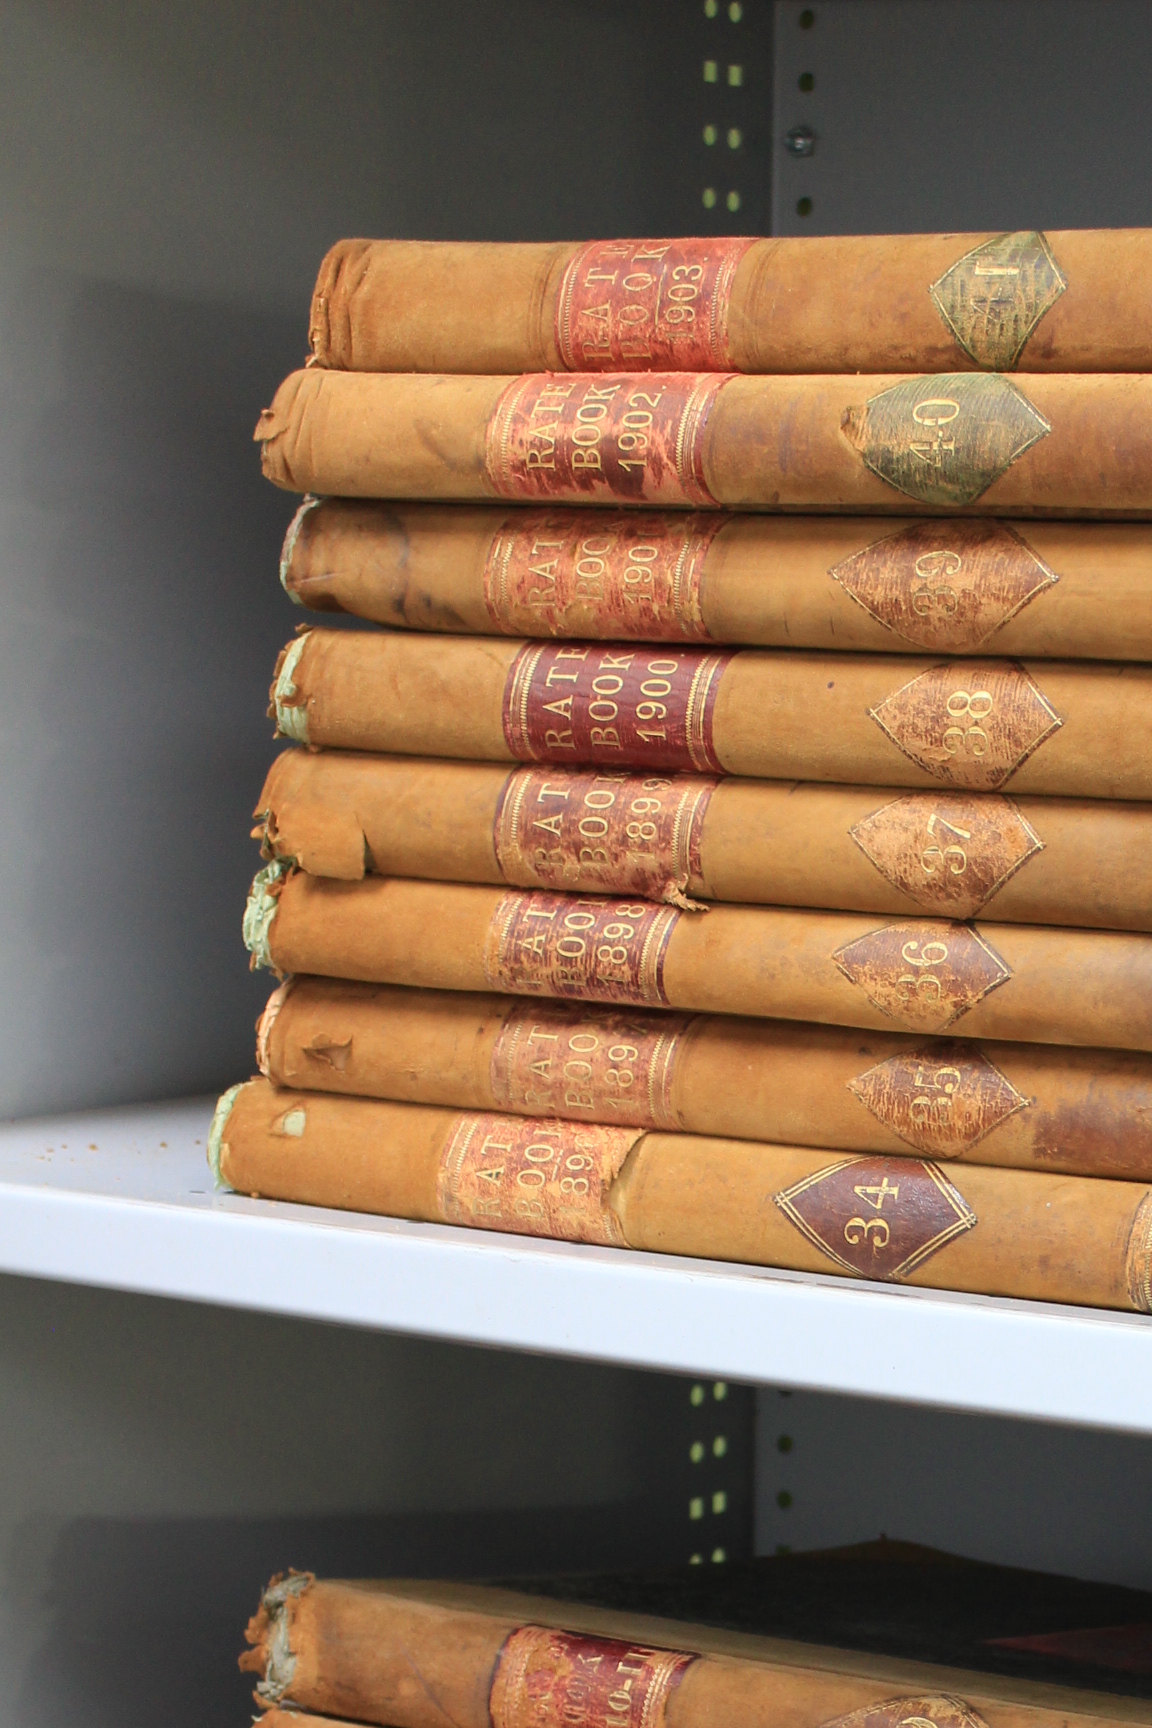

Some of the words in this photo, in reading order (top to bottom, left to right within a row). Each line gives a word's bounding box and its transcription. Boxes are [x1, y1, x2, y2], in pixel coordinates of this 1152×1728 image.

[580, 243, 630, 361] RATE
[616, 243, 672, 361] BOOK
[526, 382, 577, 470] RATE
[571, 383, 621, 470] BOOK
[908, 400, 960, 467] 40
[528, 538, 564, 608] RAT
[576, 532, 612, 602] BOO
[624, 540, 658, 605] 190
[912, 551, 962, 616] 39
[542, 646, 591, 749] RATE
[587, 652, 636, 748] BOOK
[940, 690, 993, 756] 38
[532, 782, 571, 868] RAT
[625, 777, 674, 864] 1899
[920, 814, 970, 874] 37
[525, 903, 568, 986] RAT
[896, 942, 948, 1002] 36
[525, 1026, 559, 1111] RAT
[564, 1034, 600, 1111] BOO
[604, 1045, 638, 1109] 189
[910, 1065, 960, 1124] 35
[471, 1134, 512, 1219] RAT
[845, 1178, 899, 1248] 34
